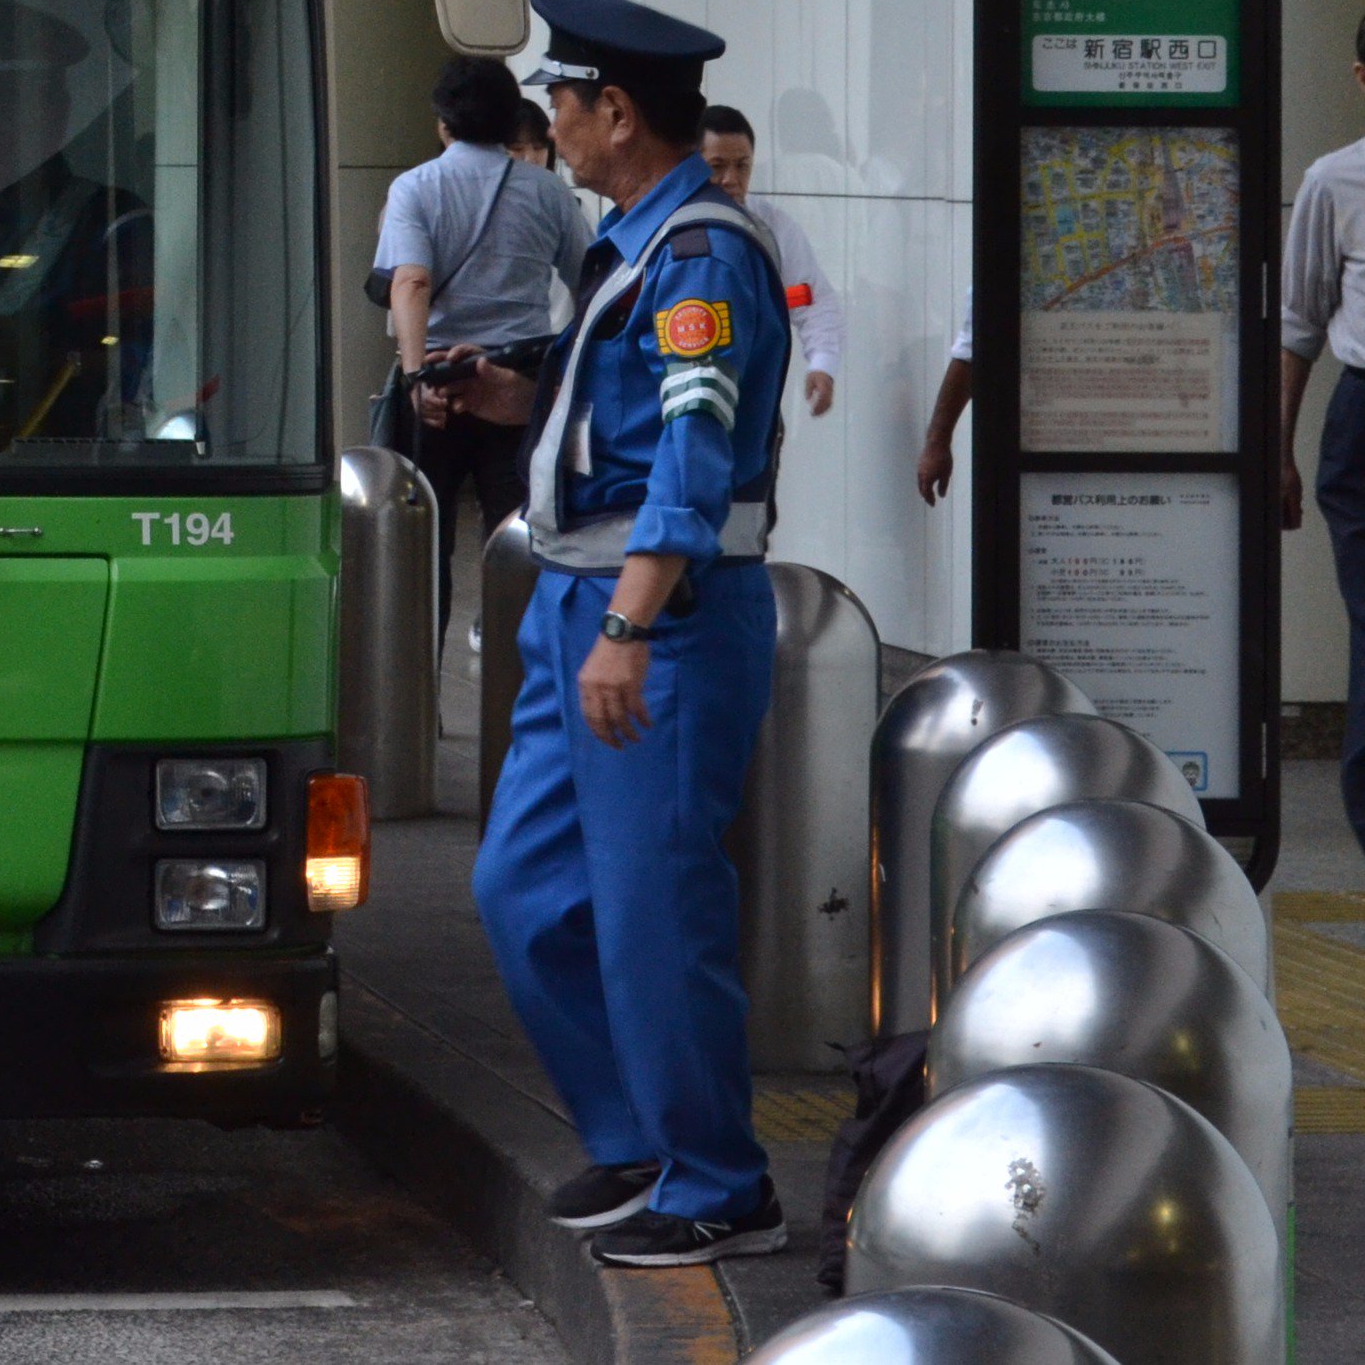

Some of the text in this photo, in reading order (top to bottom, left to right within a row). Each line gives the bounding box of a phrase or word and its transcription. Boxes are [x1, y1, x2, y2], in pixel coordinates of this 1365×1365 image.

[1084, 38, 1217, 60] 新宿駅西口
[1170, 62, 1193, 70] WEST
[131, 512, 235, 545] T194
